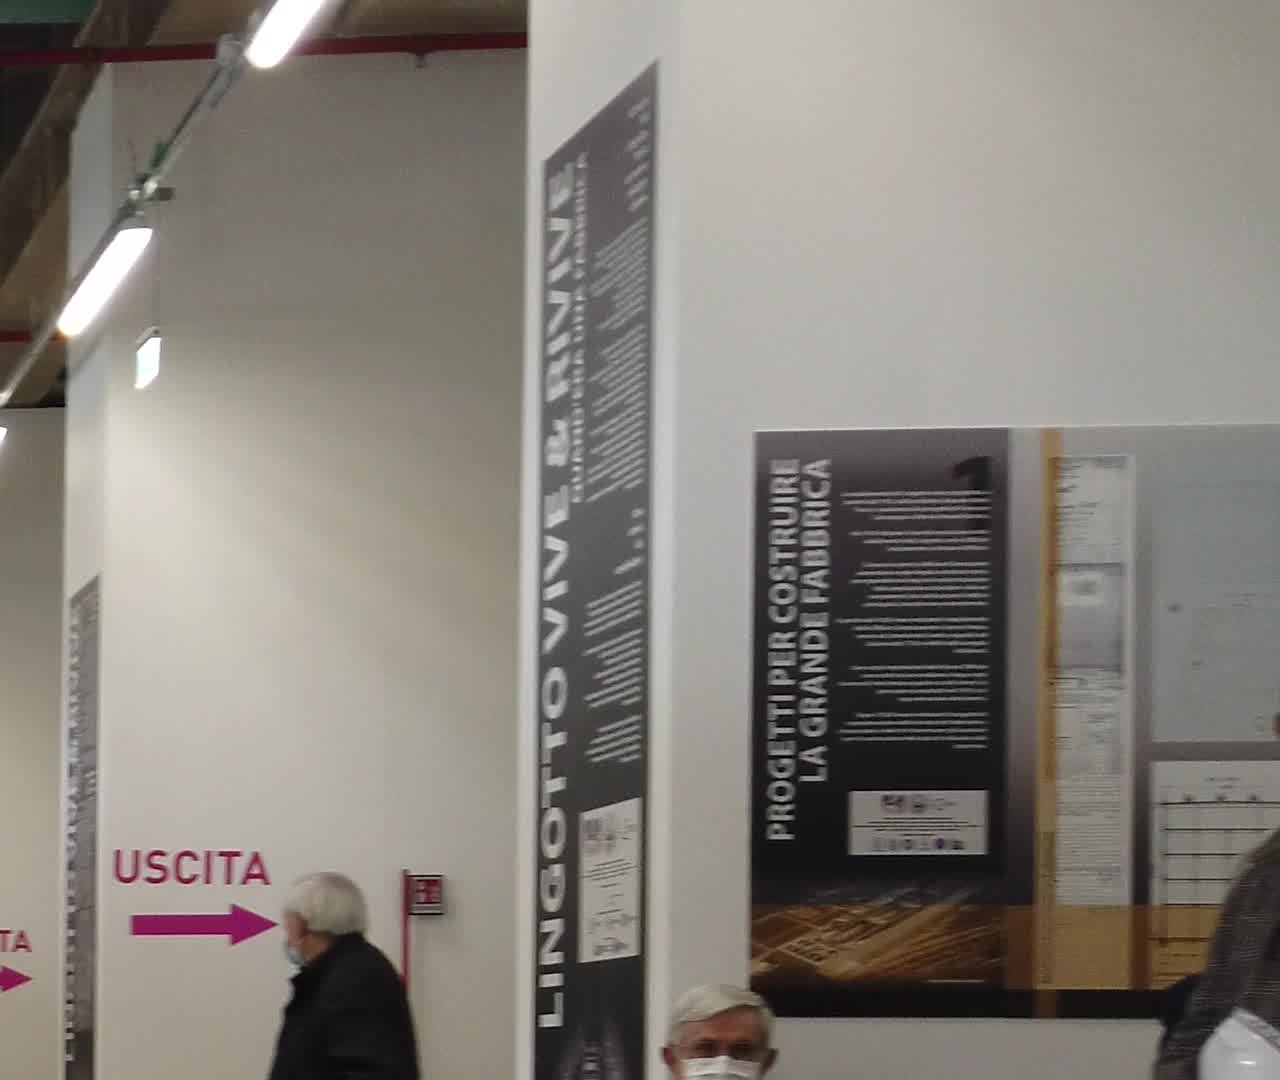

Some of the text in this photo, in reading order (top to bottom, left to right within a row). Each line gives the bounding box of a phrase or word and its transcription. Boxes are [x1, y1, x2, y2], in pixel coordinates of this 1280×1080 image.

[537, 161, 574, 1028] LINGOTTO VIVE & RIVIVE
[766, 458, 800, 841] PROGETTI PER COSTRUIRE
[799, 458, 832, 783] LA GRANDE FABBRICA
[113, 848, 273, 886] USCITA
